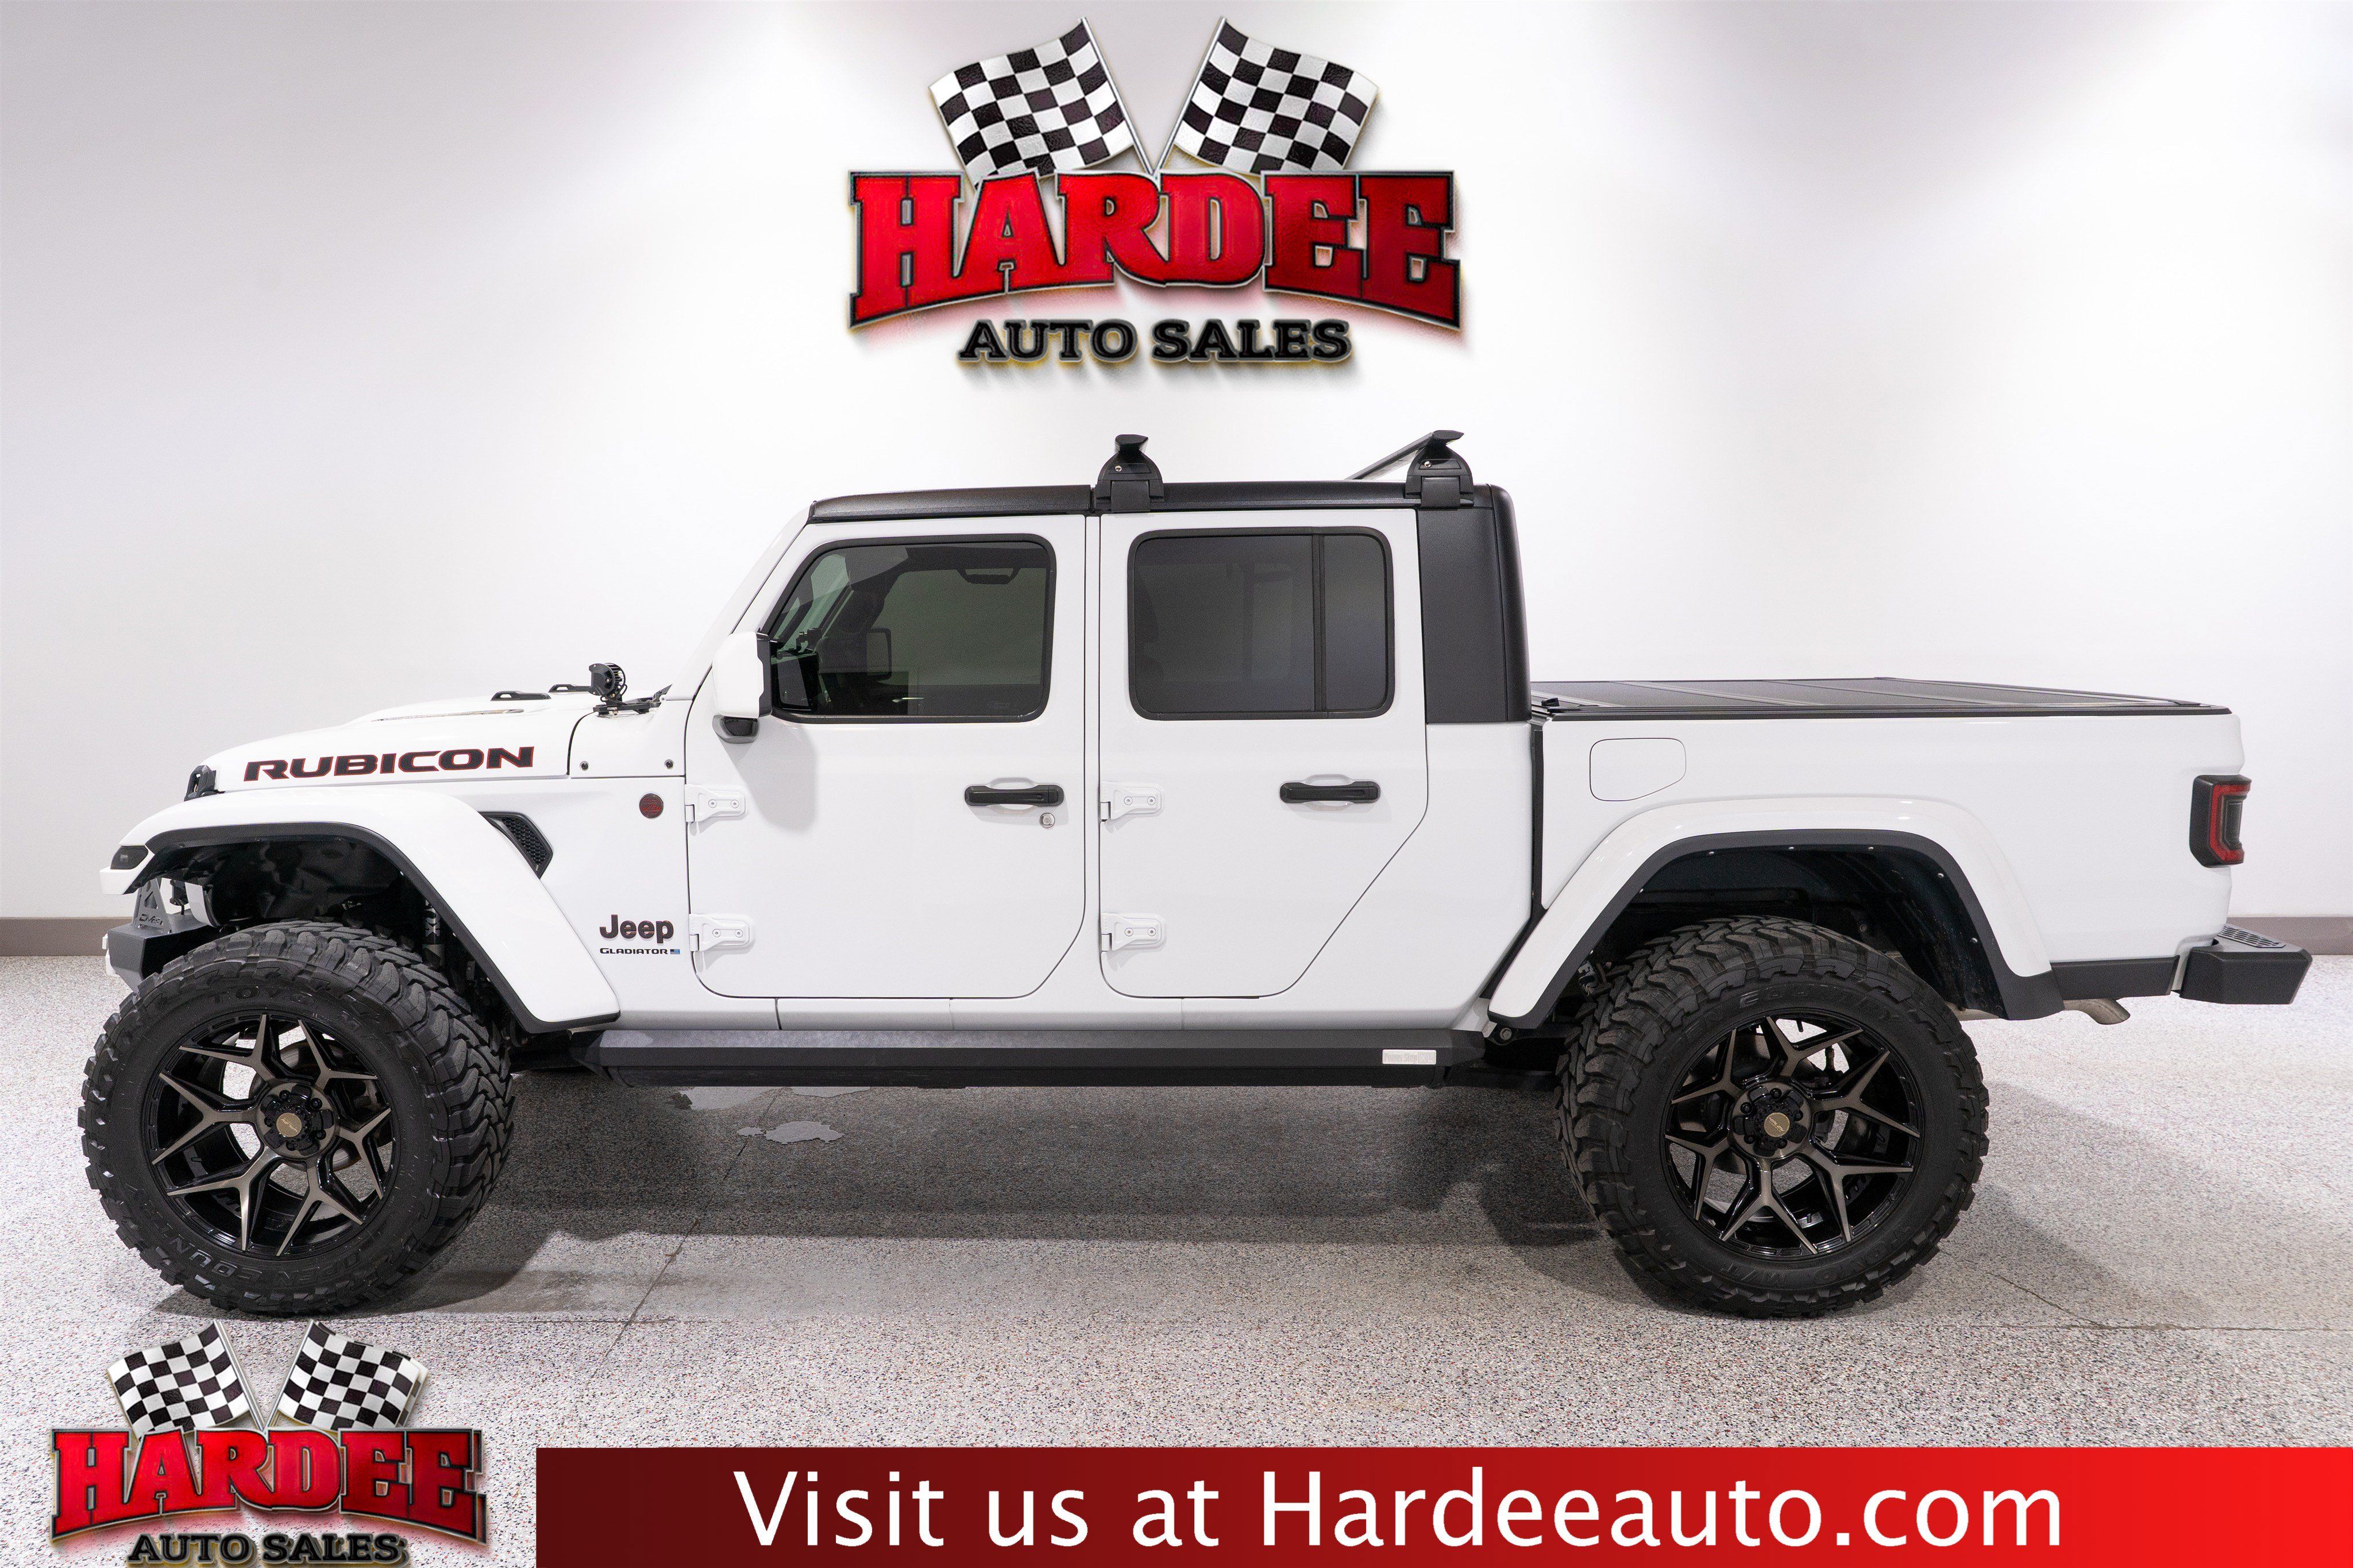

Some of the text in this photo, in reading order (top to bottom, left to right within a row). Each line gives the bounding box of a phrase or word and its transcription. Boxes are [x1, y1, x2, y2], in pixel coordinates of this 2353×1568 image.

[848, 170, 1461, 329] HARDEE
[958, 319, 1352, 362] AUTO SALES
[244, 747, 534, 782] RUBICON
[600, 914, 673, 943] Jeep
[206, 984, 316, 1006] TOYO
